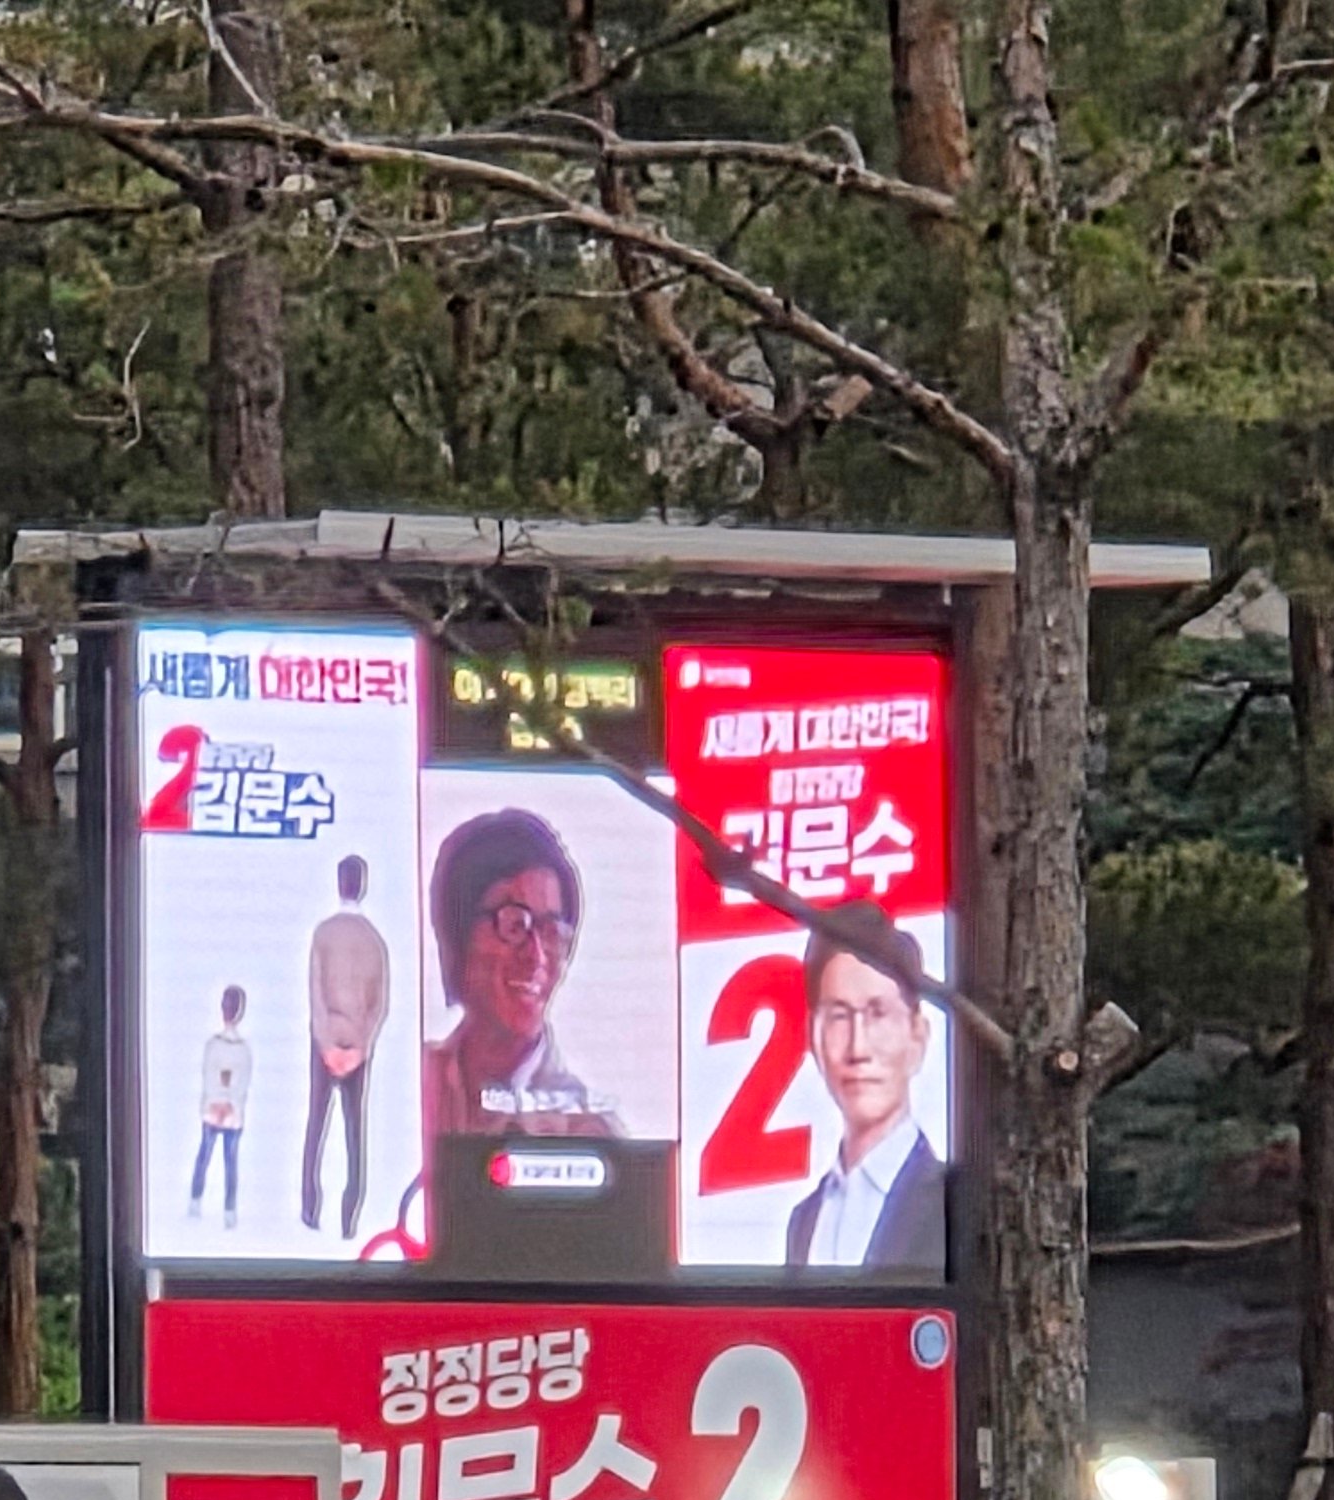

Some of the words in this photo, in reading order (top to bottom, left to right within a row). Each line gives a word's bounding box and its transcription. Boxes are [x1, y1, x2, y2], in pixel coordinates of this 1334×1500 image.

[147, 651, 250, 701] 새롭게
[142, 724, 204, 831] 2
[191, 770, 335, 839] 김문수
[698, 954, 812, 1197] 2
[380, 1327, 590, 1424] 정정당당
